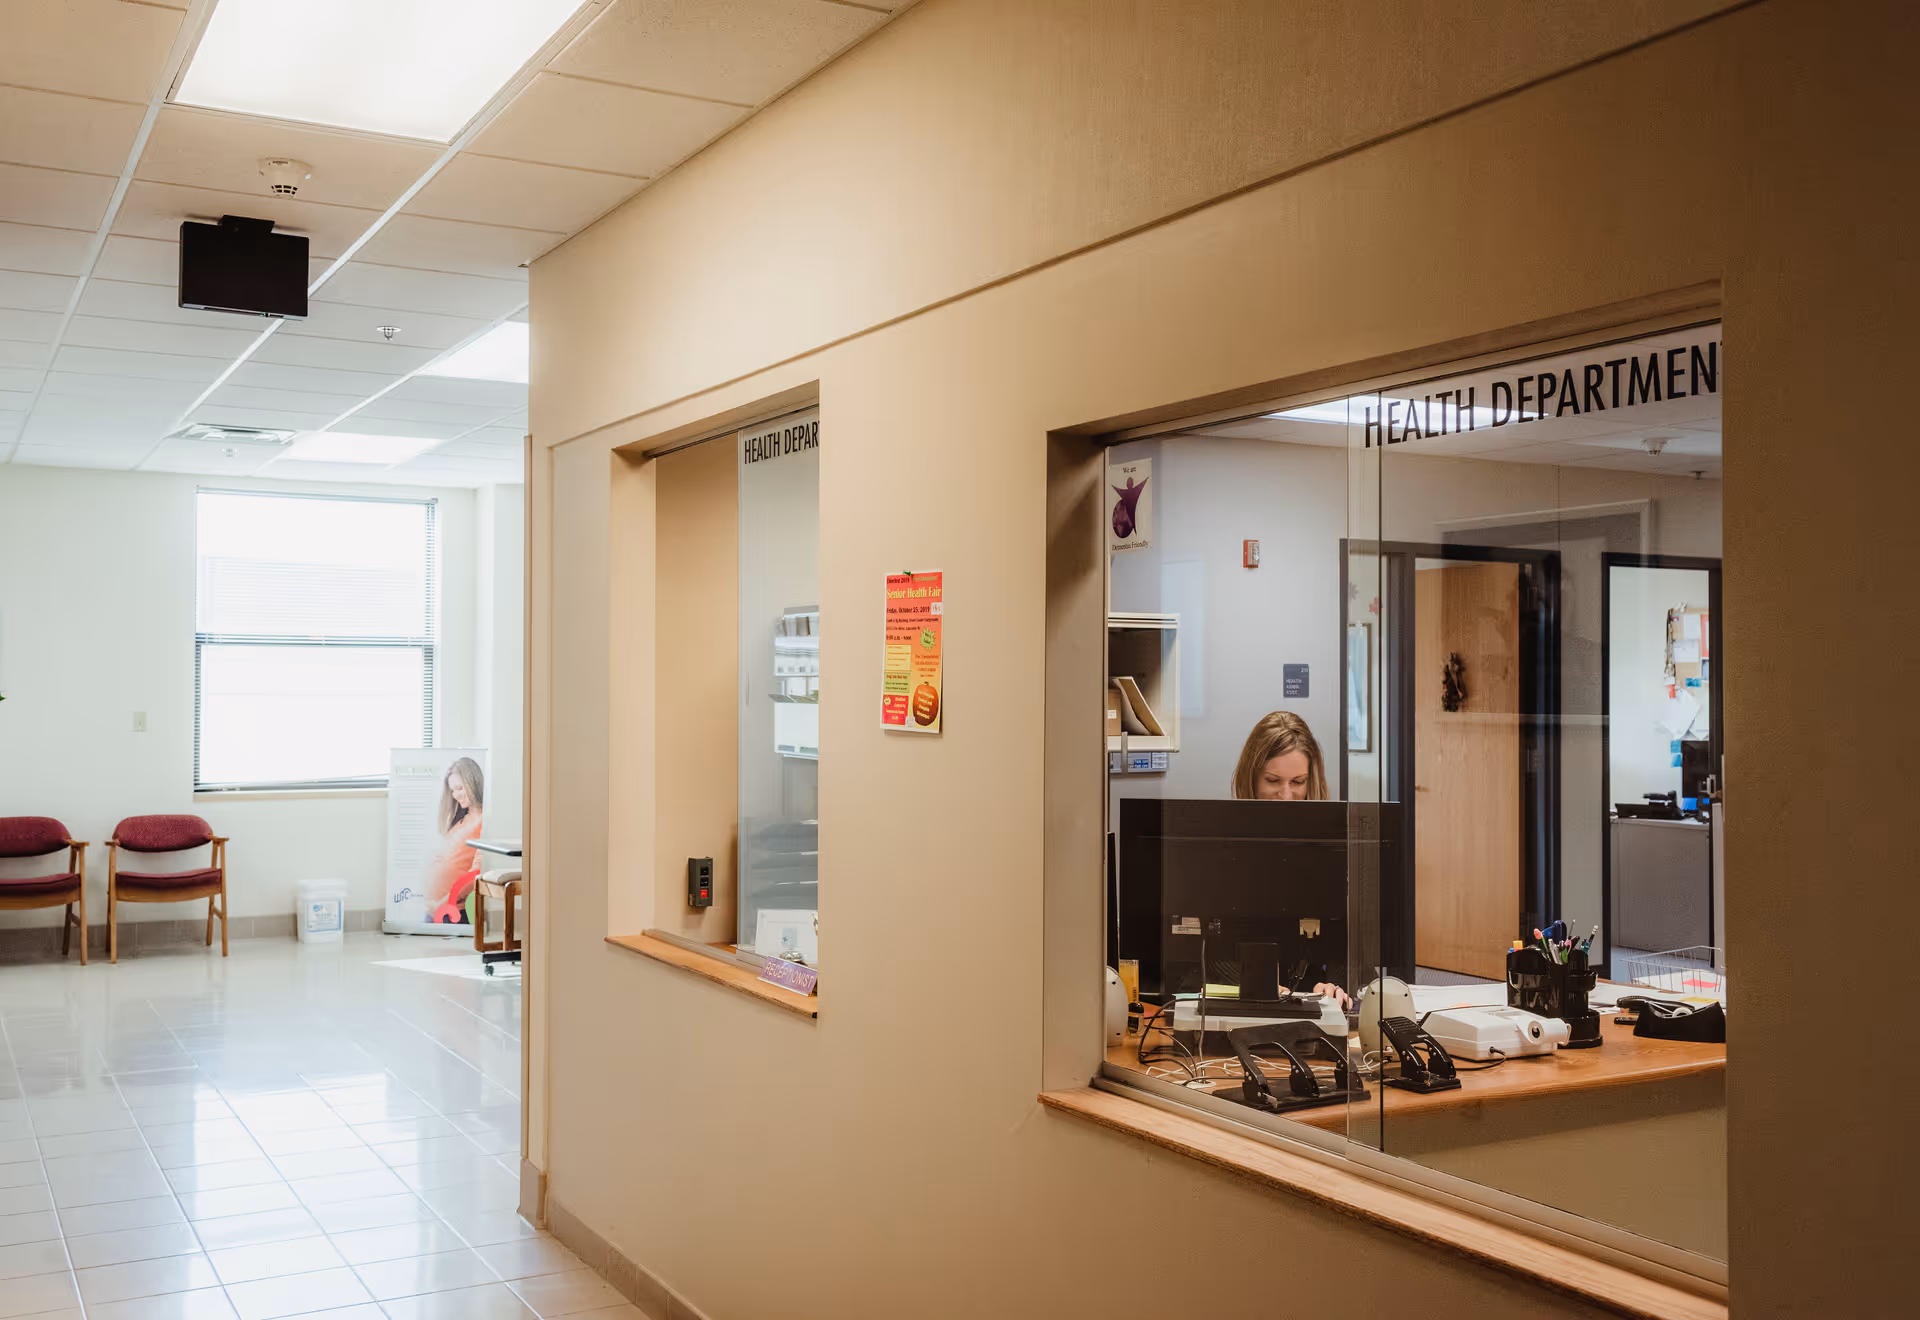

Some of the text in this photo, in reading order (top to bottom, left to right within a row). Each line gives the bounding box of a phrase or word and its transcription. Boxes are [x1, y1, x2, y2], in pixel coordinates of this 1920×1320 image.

[1364, 340, 1722, 448] HEALTH DEPARTMEN
[745, 421, 819, 464] HEALTH DEPAR
[1131, 540, 1148, 549] Friendly
[887, 586, 942, 599] Senior Health Fair
[765, 962, 814, 988] RECEPTIONIST
